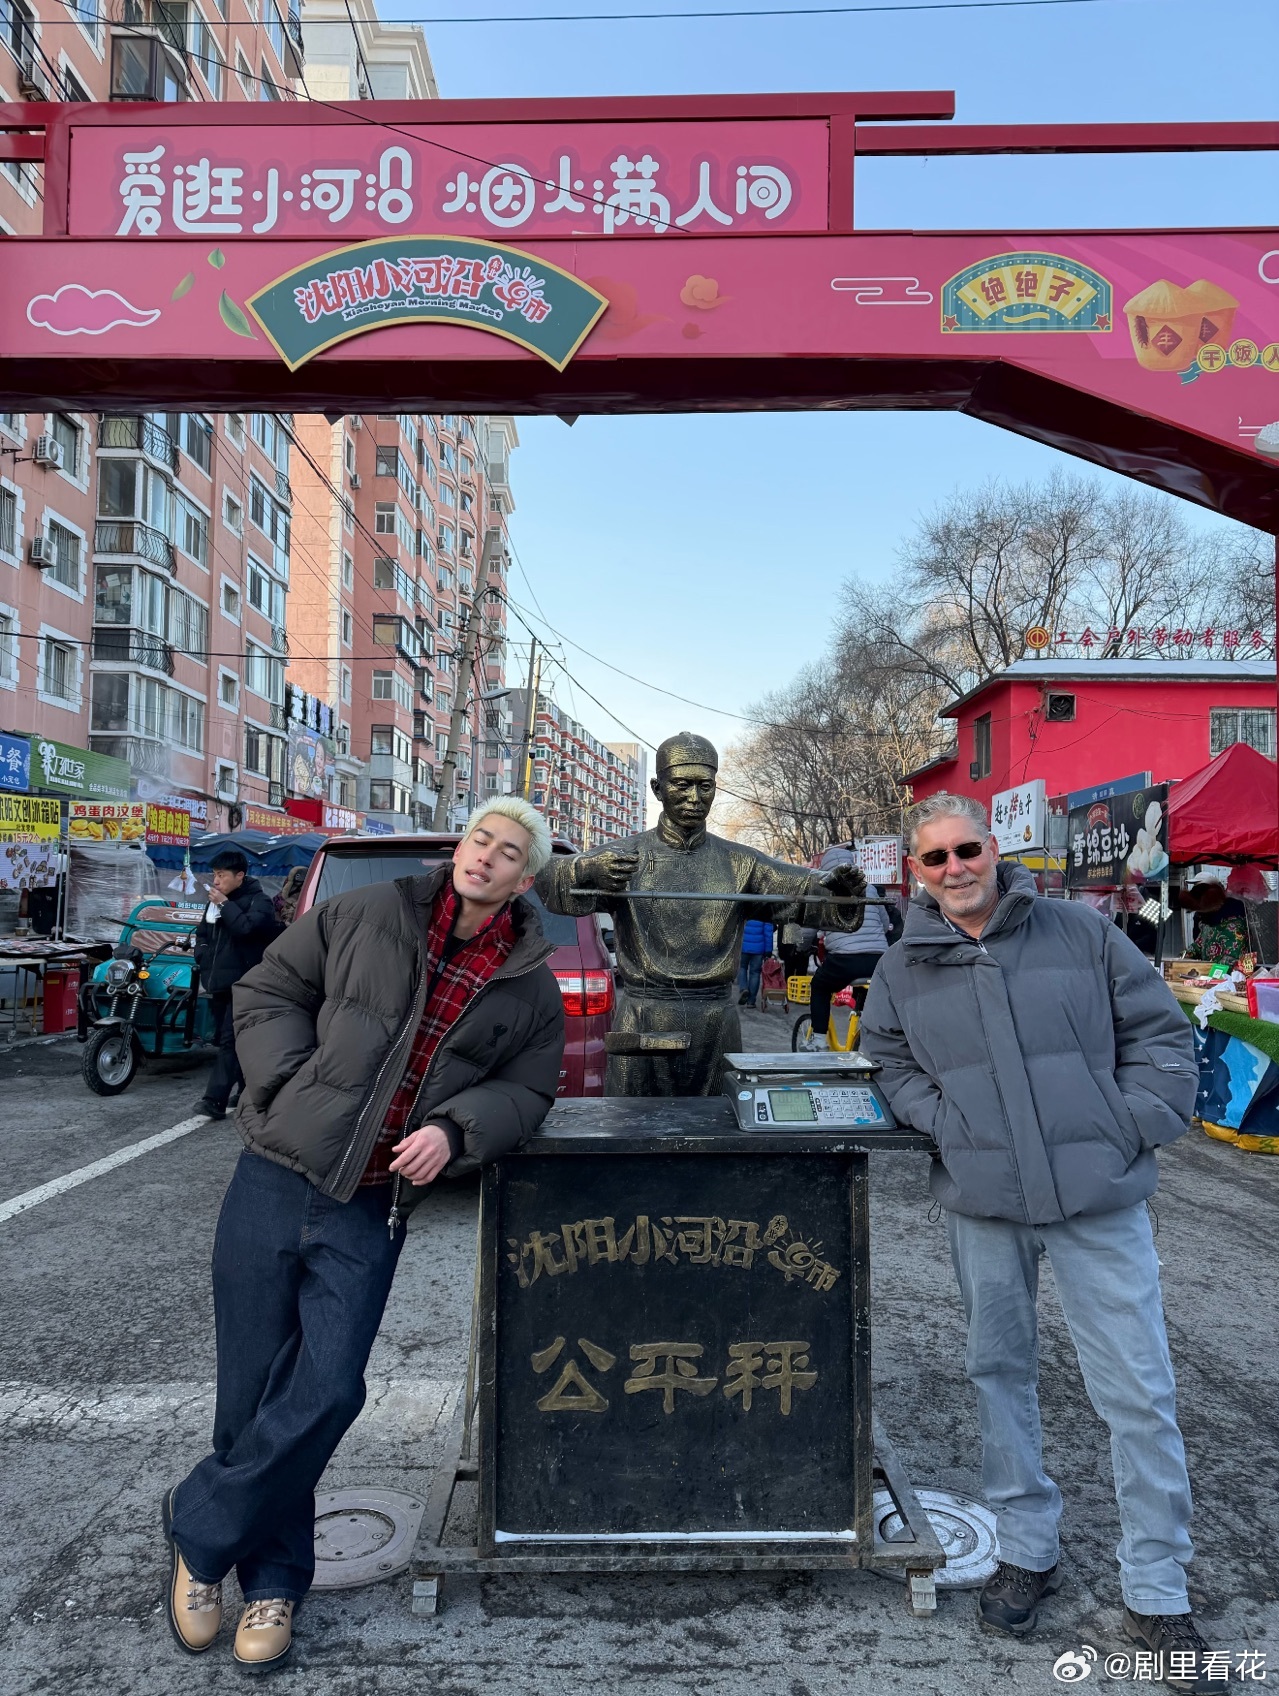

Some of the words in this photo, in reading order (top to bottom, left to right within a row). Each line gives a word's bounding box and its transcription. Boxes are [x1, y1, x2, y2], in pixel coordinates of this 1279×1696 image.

[116, 145, 413, 235] 爱逛小河沿
[442, 154, 792, 234] 烟火满人间
[981, 270, 1075, 306] 绝绝子
[408, 299, 456, 308] Morning
[459, 301, 502, 319] Market
[1202, 344, 1279, 368] 干饭人
[1054, 626, 1277, 650] 工会户外劳动者服务
[74, 805, 144, 817] 鸡蛋肉汉堡
[531, 1336, 818, 1415] 公平秤
